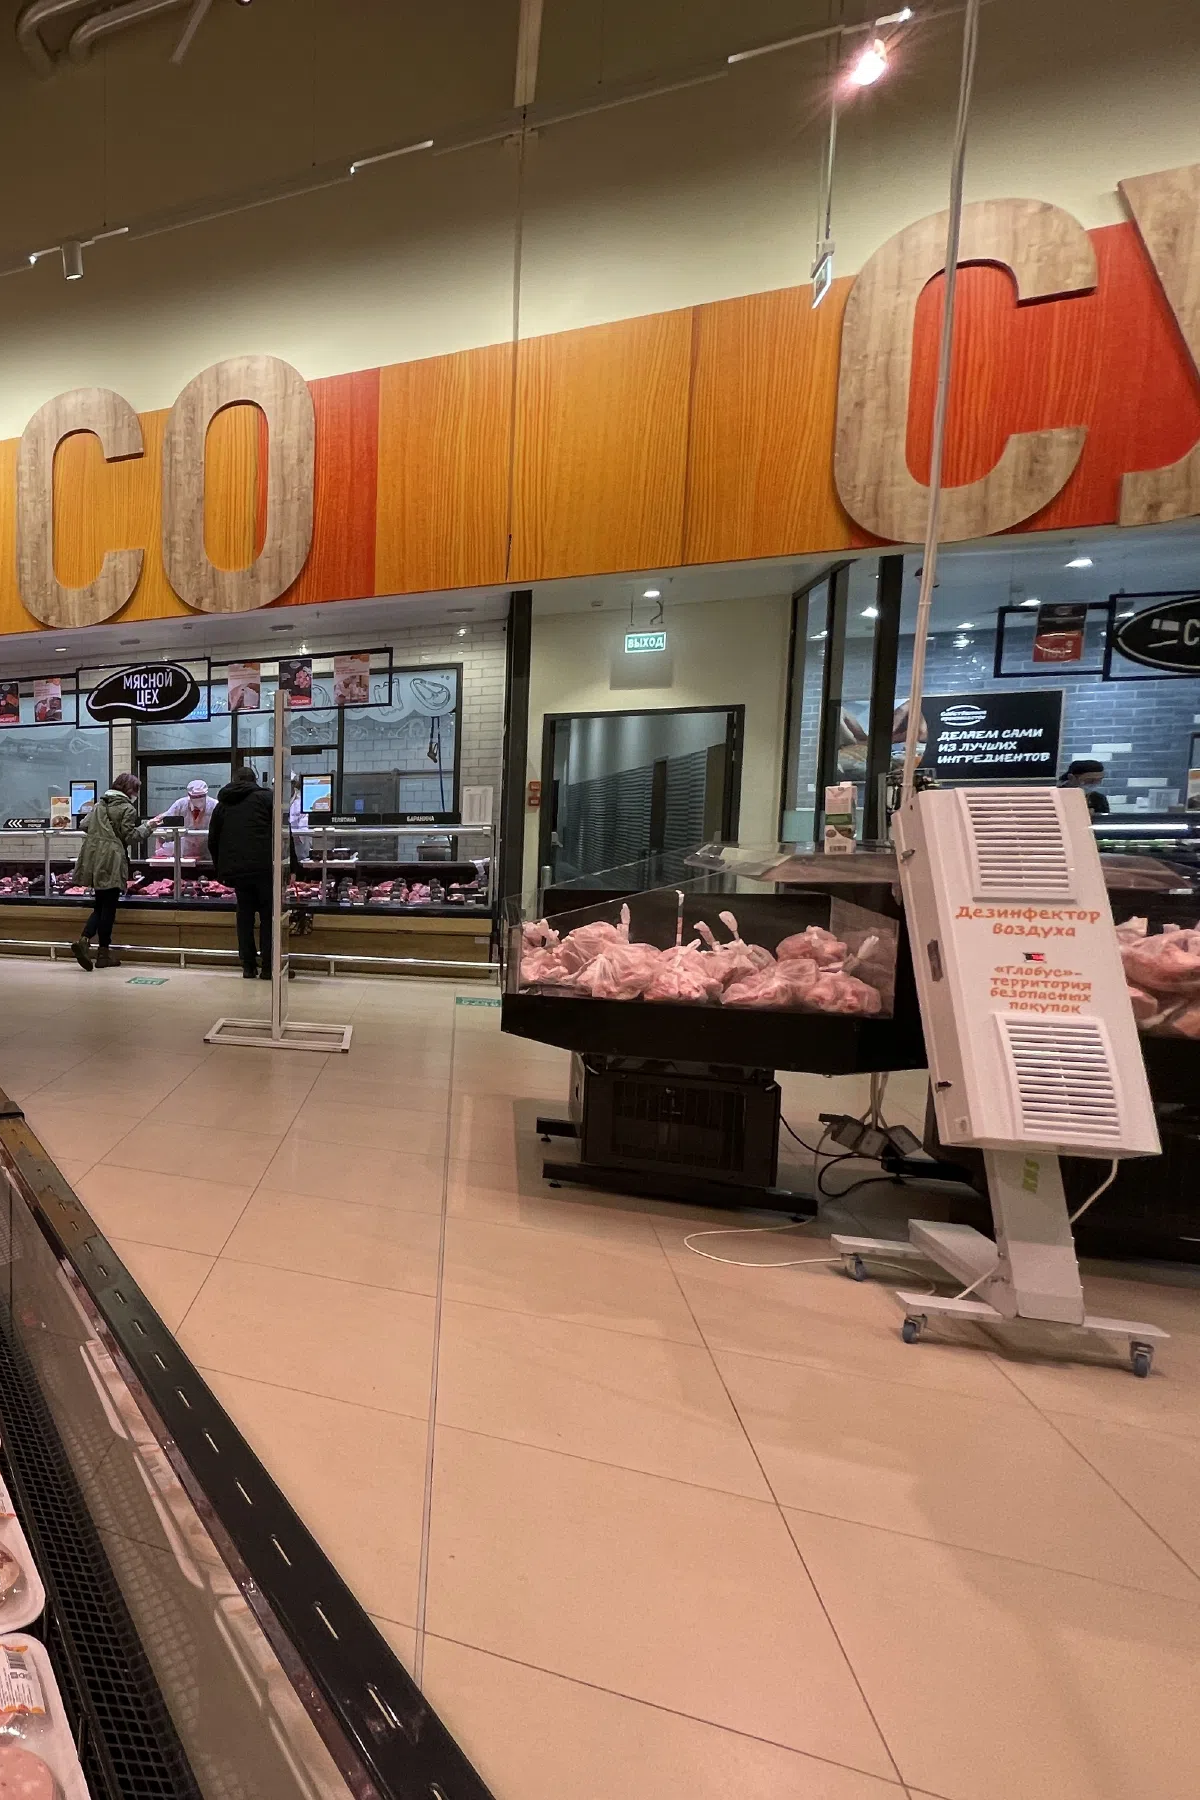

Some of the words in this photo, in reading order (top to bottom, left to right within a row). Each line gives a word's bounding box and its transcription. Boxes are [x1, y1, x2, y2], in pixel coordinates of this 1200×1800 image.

[628, 636, 664, 649] ВЫХОД
[123, 669, 173, 690] МЯСНОЙ
[136, 688, 160, 707] ЦЕХ
[937, 730, 999, 742] ДЕЛАЕМ
[1001, 728, 1044, 739] САМИ
[938, 742, 957, 752] ИЗ
[958, 741, 1018, 752] ЛУЧШИХ
[937, 752, 1050, 764] ИНГРЕДИЕНТОВ
[955, 906, 1101, 924] Дезинфектор
[990, 977, 1092, 992] территория
[990, 987, 1092, 1003] безопасных
[1009, 1001, 1082, 1014] покупок
